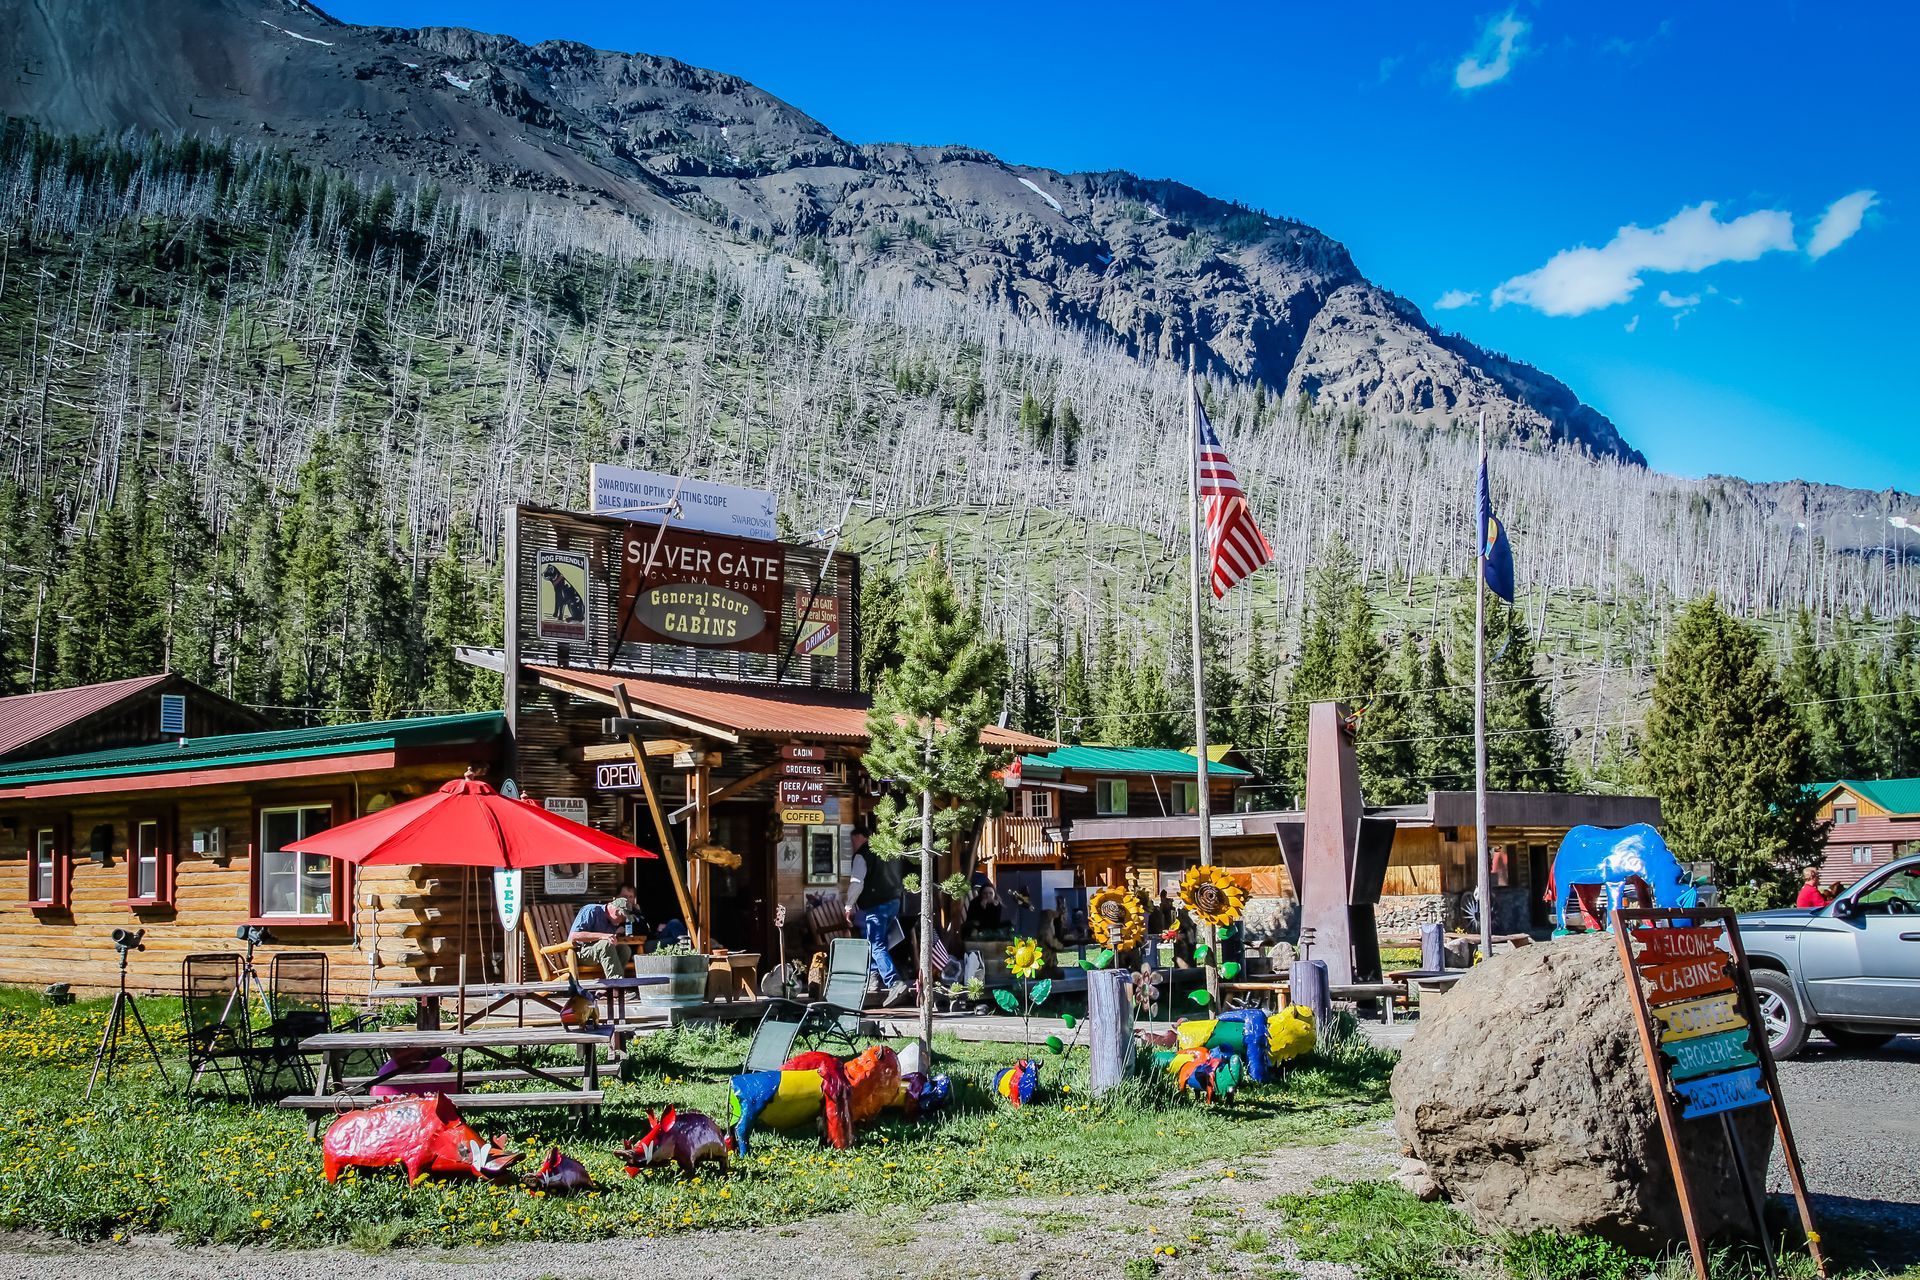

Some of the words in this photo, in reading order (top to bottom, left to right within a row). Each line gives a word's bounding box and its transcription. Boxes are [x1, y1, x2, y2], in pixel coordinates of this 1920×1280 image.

[598, 477, 641, 495] SWAROVSKI
[643, 485, 665, 498] OPTIK
[703, 494, 727, 508] SCOPE
[598, 494, 621, 508] SALES
[623, 498, 639, 509] AND
[731, 514, 771, 528] SWAROVSKI
[750, 528, 771, 539] OPTIK
[541, 555, 554, 563] DOG
[555, 555, 584, 568] FRIENDLY
[627, 540, 711, 573] SILVER
[717, 552, 780, 581] GATE
[725, 580, 766, 593] 59081
[650, 590, 708, 607] General
[711, 593, 749, 616] Store
[801, 596, 819, 608] SILER
[820, 599, 833, 610] GATE
[698, 607, 706, 616] &
[821, 610, 837, 622] Store
[665, 612, 737, 637] CABINS
[805, 624, 831, 652] DRINKS
[792, 748, 813, 757] CABIN
[599, 765, 639, 787] OPEN
[785, 765, 821, 775] GROCERIES
[783, 781, 824, 792] BEER/WINE
[548, 799, 584, 809] BEWARE
[786, 794, 800, 803] POP
[811, 794, 822, 803] ICE
[786, 812, 820, 822] COFFEE
[1660, 961, 1721, 993] CABINS
[1669, 1001, 1734, 1034] COFFEE
[1677, 1037, 1743, 1070] GROCERIES
